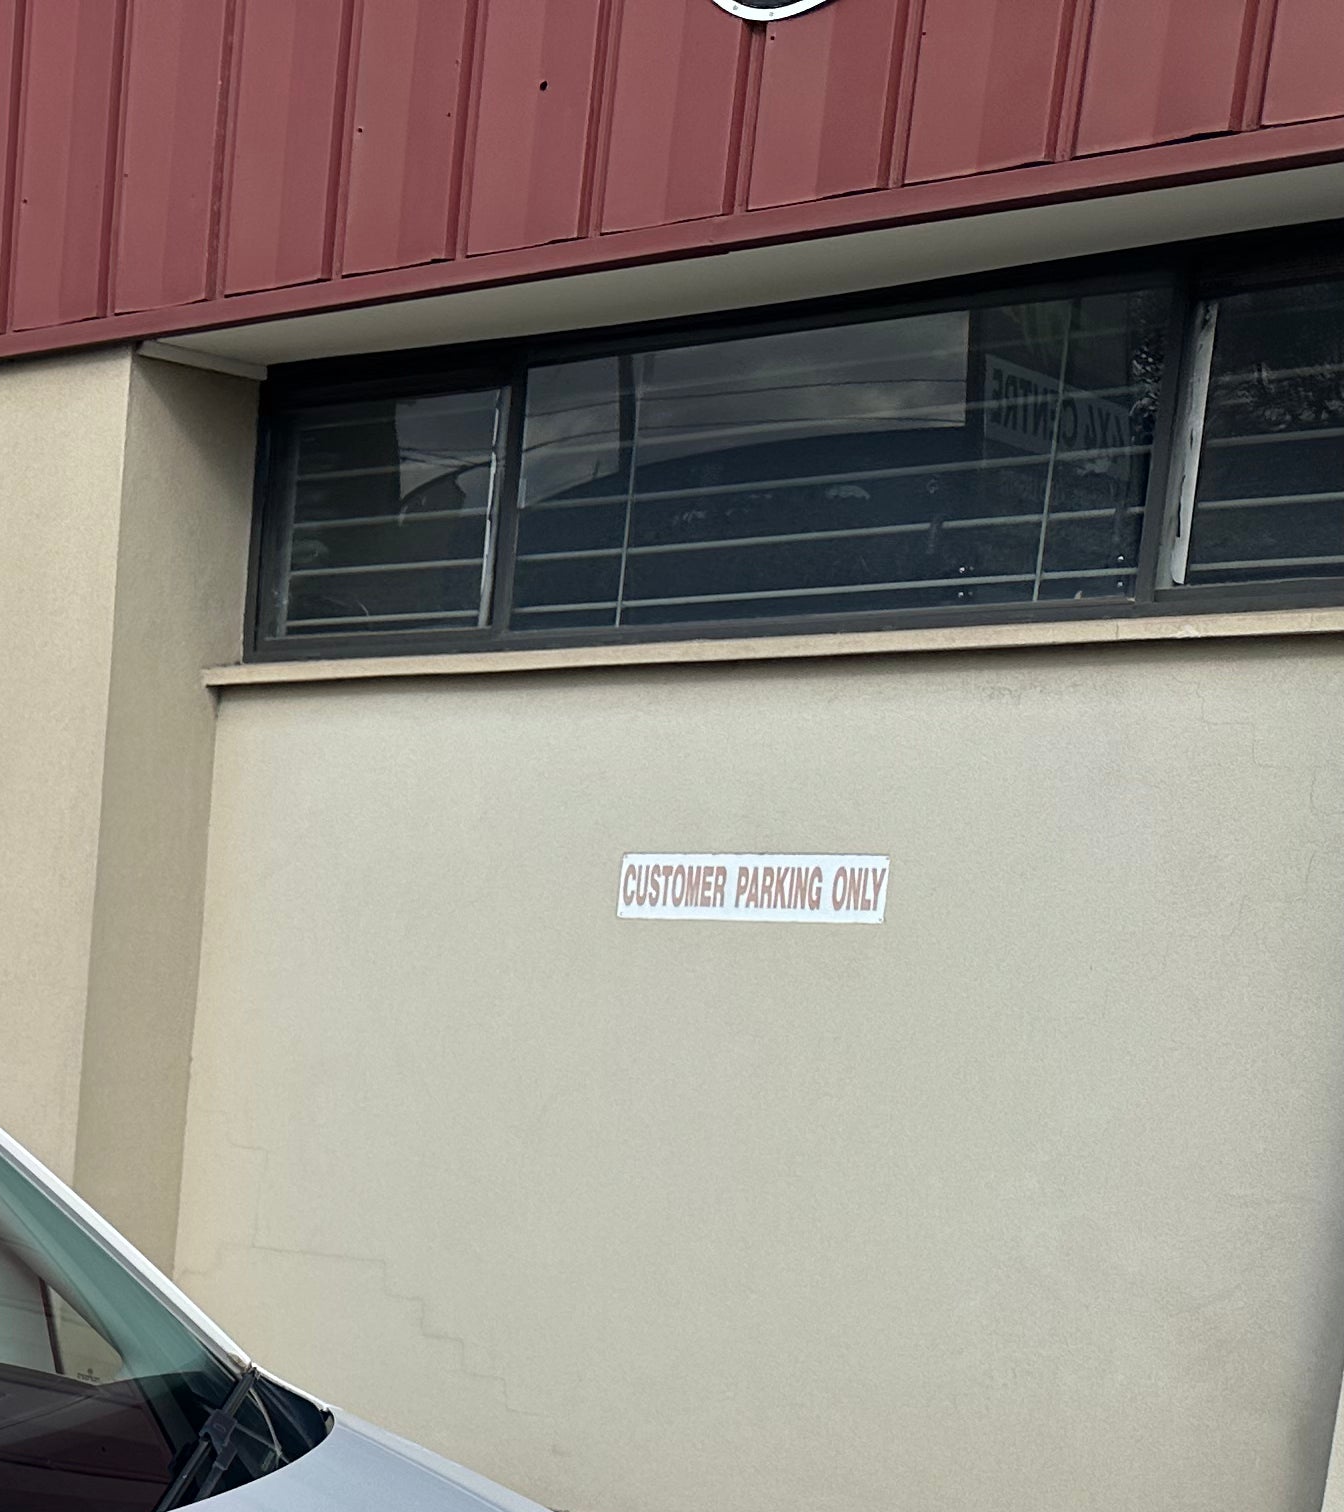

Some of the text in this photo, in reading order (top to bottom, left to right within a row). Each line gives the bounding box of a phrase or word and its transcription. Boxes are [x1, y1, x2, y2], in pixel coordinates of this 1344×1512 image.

[622, 863, 887, 912] CUSTOMER PARKING ONLY
